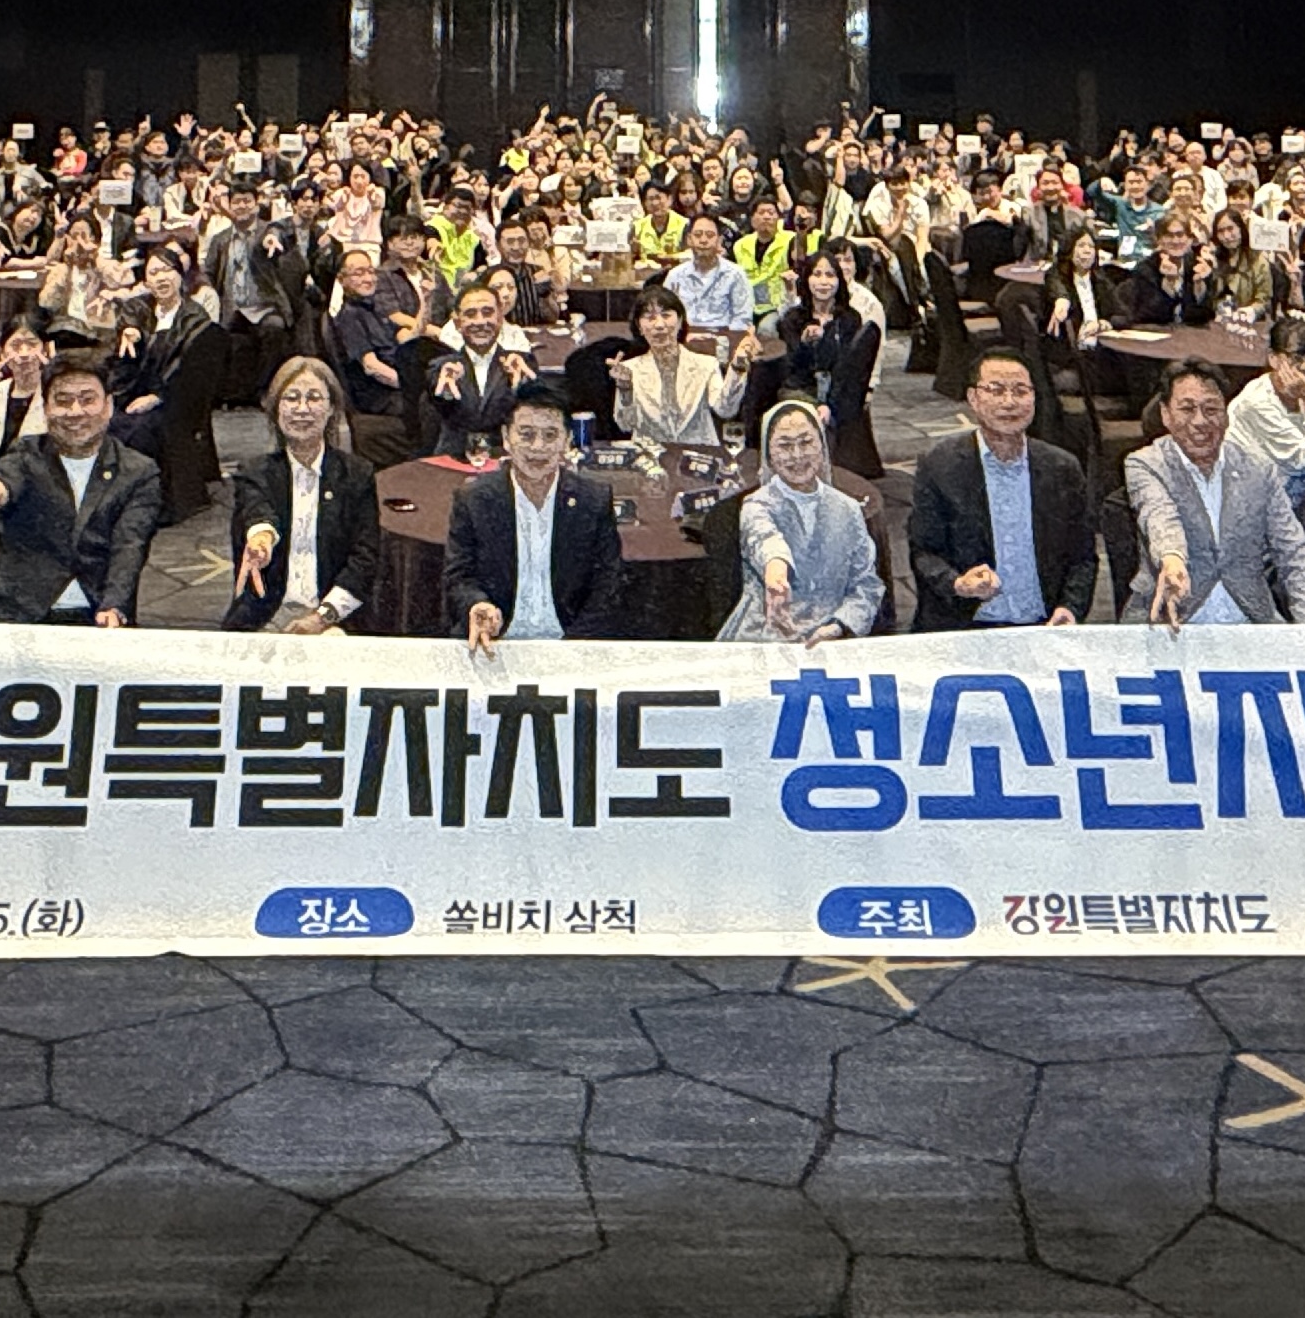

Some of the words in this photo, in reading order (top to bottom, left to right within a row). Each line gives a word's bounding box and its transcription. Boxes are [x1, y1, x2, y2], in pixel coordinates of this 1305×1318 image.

[297, 897, 371, 934] 장소
[442, 899, 552, 934] 쏠비치
[564, 899, 636, 934] 삼척
[858, 899, 934, 935] 주최
[1003, 892, 1276, 934] 강원특별자치도
